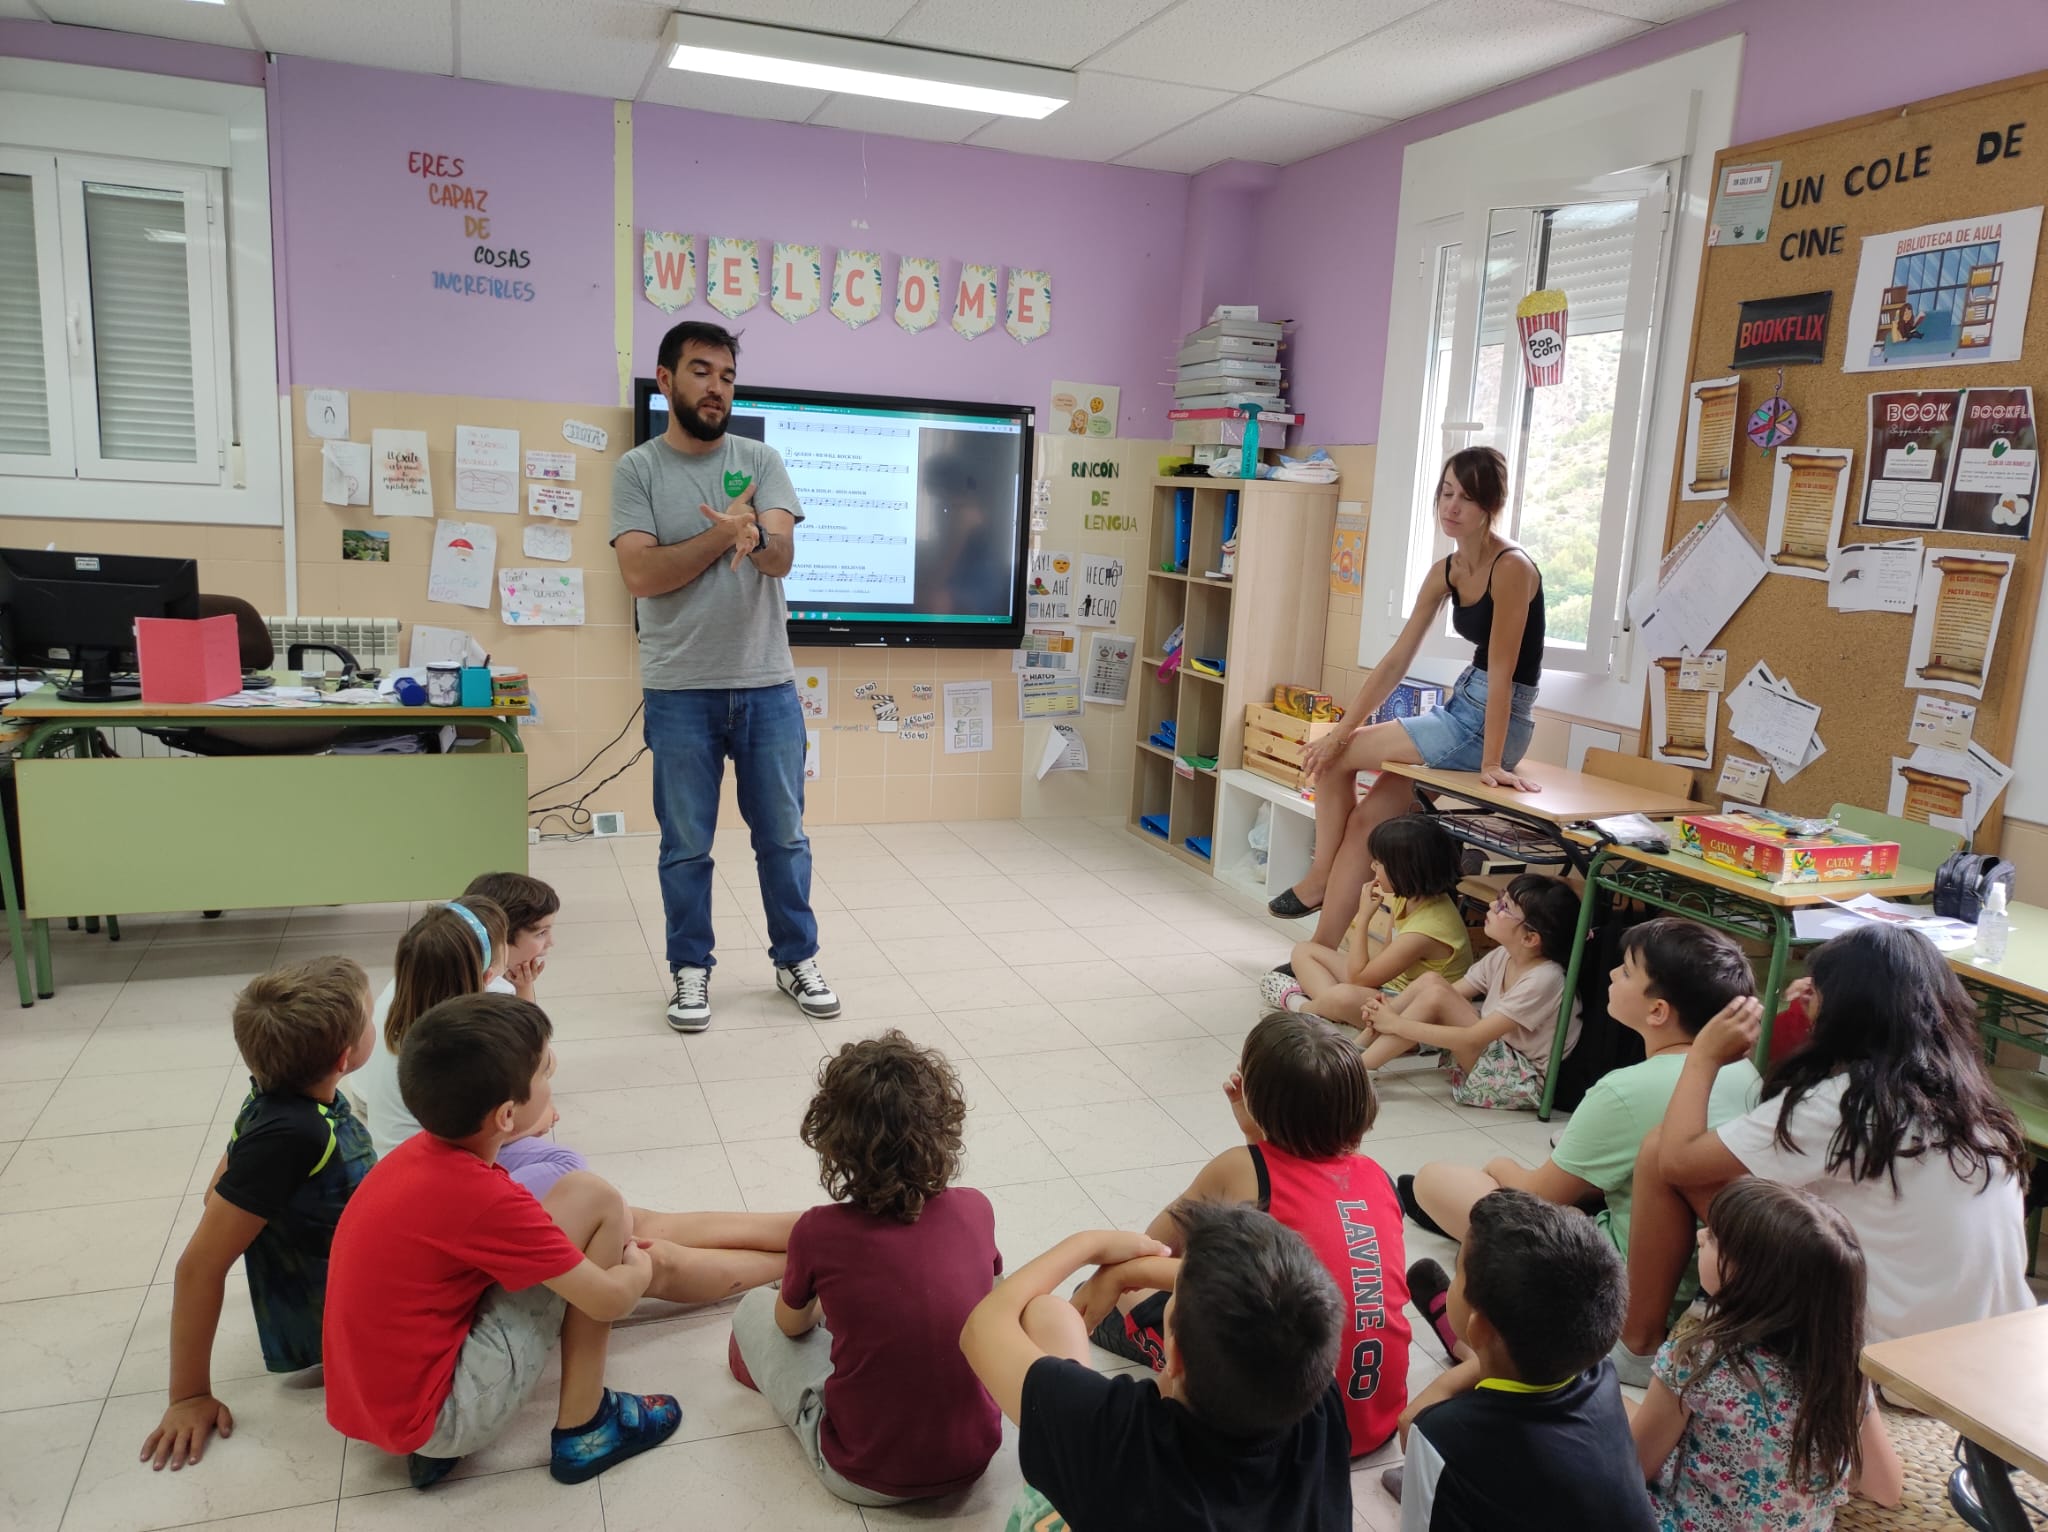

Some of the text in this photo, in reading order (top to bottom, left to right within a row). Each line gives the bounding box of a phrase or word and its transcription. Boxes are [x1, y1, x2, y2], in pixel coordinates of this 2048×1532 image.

[408, 151, 465, 178] ERES
[1781, 122, 2026, 209] UN COLE DE
[429, 183, 489, 213] CAPAZ
[464, 215, 491, 240] DE
[1780, 225, 1846, 262] CINE
[1896, 224, 2002, 256] BIBLIOTECA DE AULA
[474, 245, 531, 268] COSAS
[654, 250, 1035, 324] WELCOME
[1739, 314, 1825, 349] BOOKFLIX
[1528, 336, 1553, 350] Pop
[1532, 343, 1562, 359] Corn
[1887, 402, 1952, 422] BOOK
[1071, 459, 1120, 479] RINCÓN
[1091, 490, 1110, 506] DE
[1084, 514, 1138, 533] LENGUA
[1052, 577, 1070, 596] AHÍ
[1086, 566, 1119, 587] HECHO
[1039, 602, 1056, 619] HAY
[1710, 839, 1738, 856] CATAN
[1826, 857, 1855, 869] CATAN
[1336, 1199, 1386, 1332] LAVINE
[1347, 1338, 1384, 1400] 8
